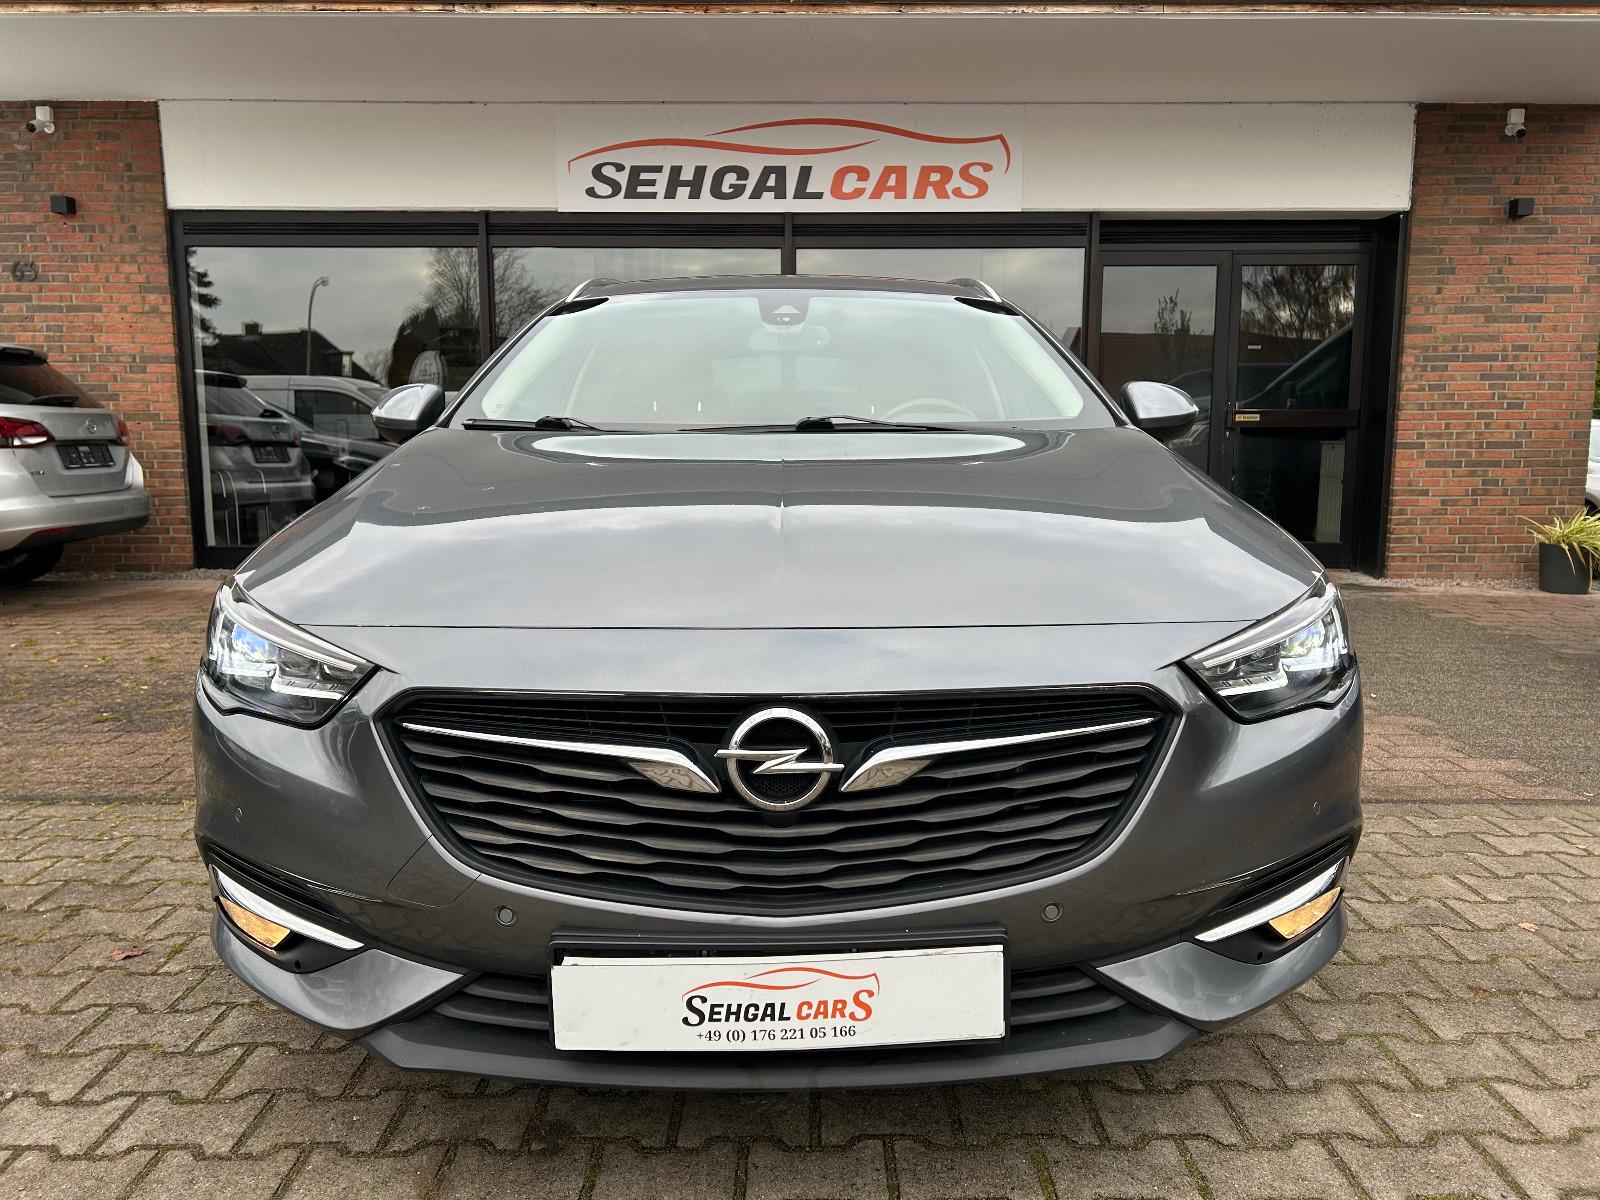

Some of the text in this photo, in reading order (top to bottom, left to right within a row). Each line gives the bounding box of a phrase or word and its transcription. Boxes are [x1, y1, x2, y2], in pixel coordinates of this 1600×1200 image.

[681, 988, 875, 1027] SEHGAL CARS
[696, 1025, 857, 1043] +49 (0) 176 221 05 166
